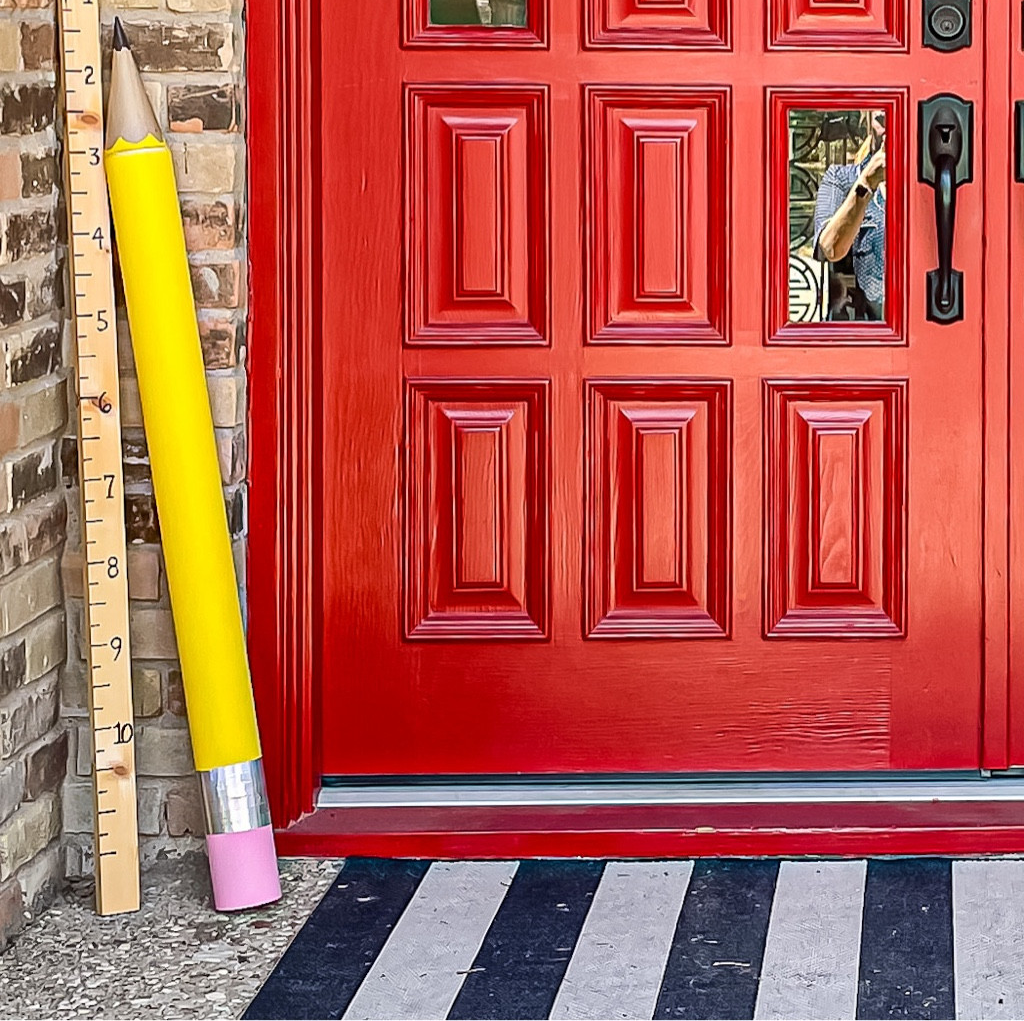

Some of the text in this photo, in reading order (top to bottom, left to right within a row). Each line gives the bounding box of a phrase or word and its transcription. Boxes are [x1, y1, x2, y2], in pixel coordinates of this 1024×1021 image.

[84, 65, 95, 85] 2
[88, 147, 100, 166] 3
[92, 227, 104, 250] 4
[96, 310, 108, 332] 5
[97, 391, 112, 414] 6
[103, 474, 116, 499] 7
[107, 556, 119, 579] 8
[110, 636, 122, 662] 9
[113, 721, 133, 745] 10
